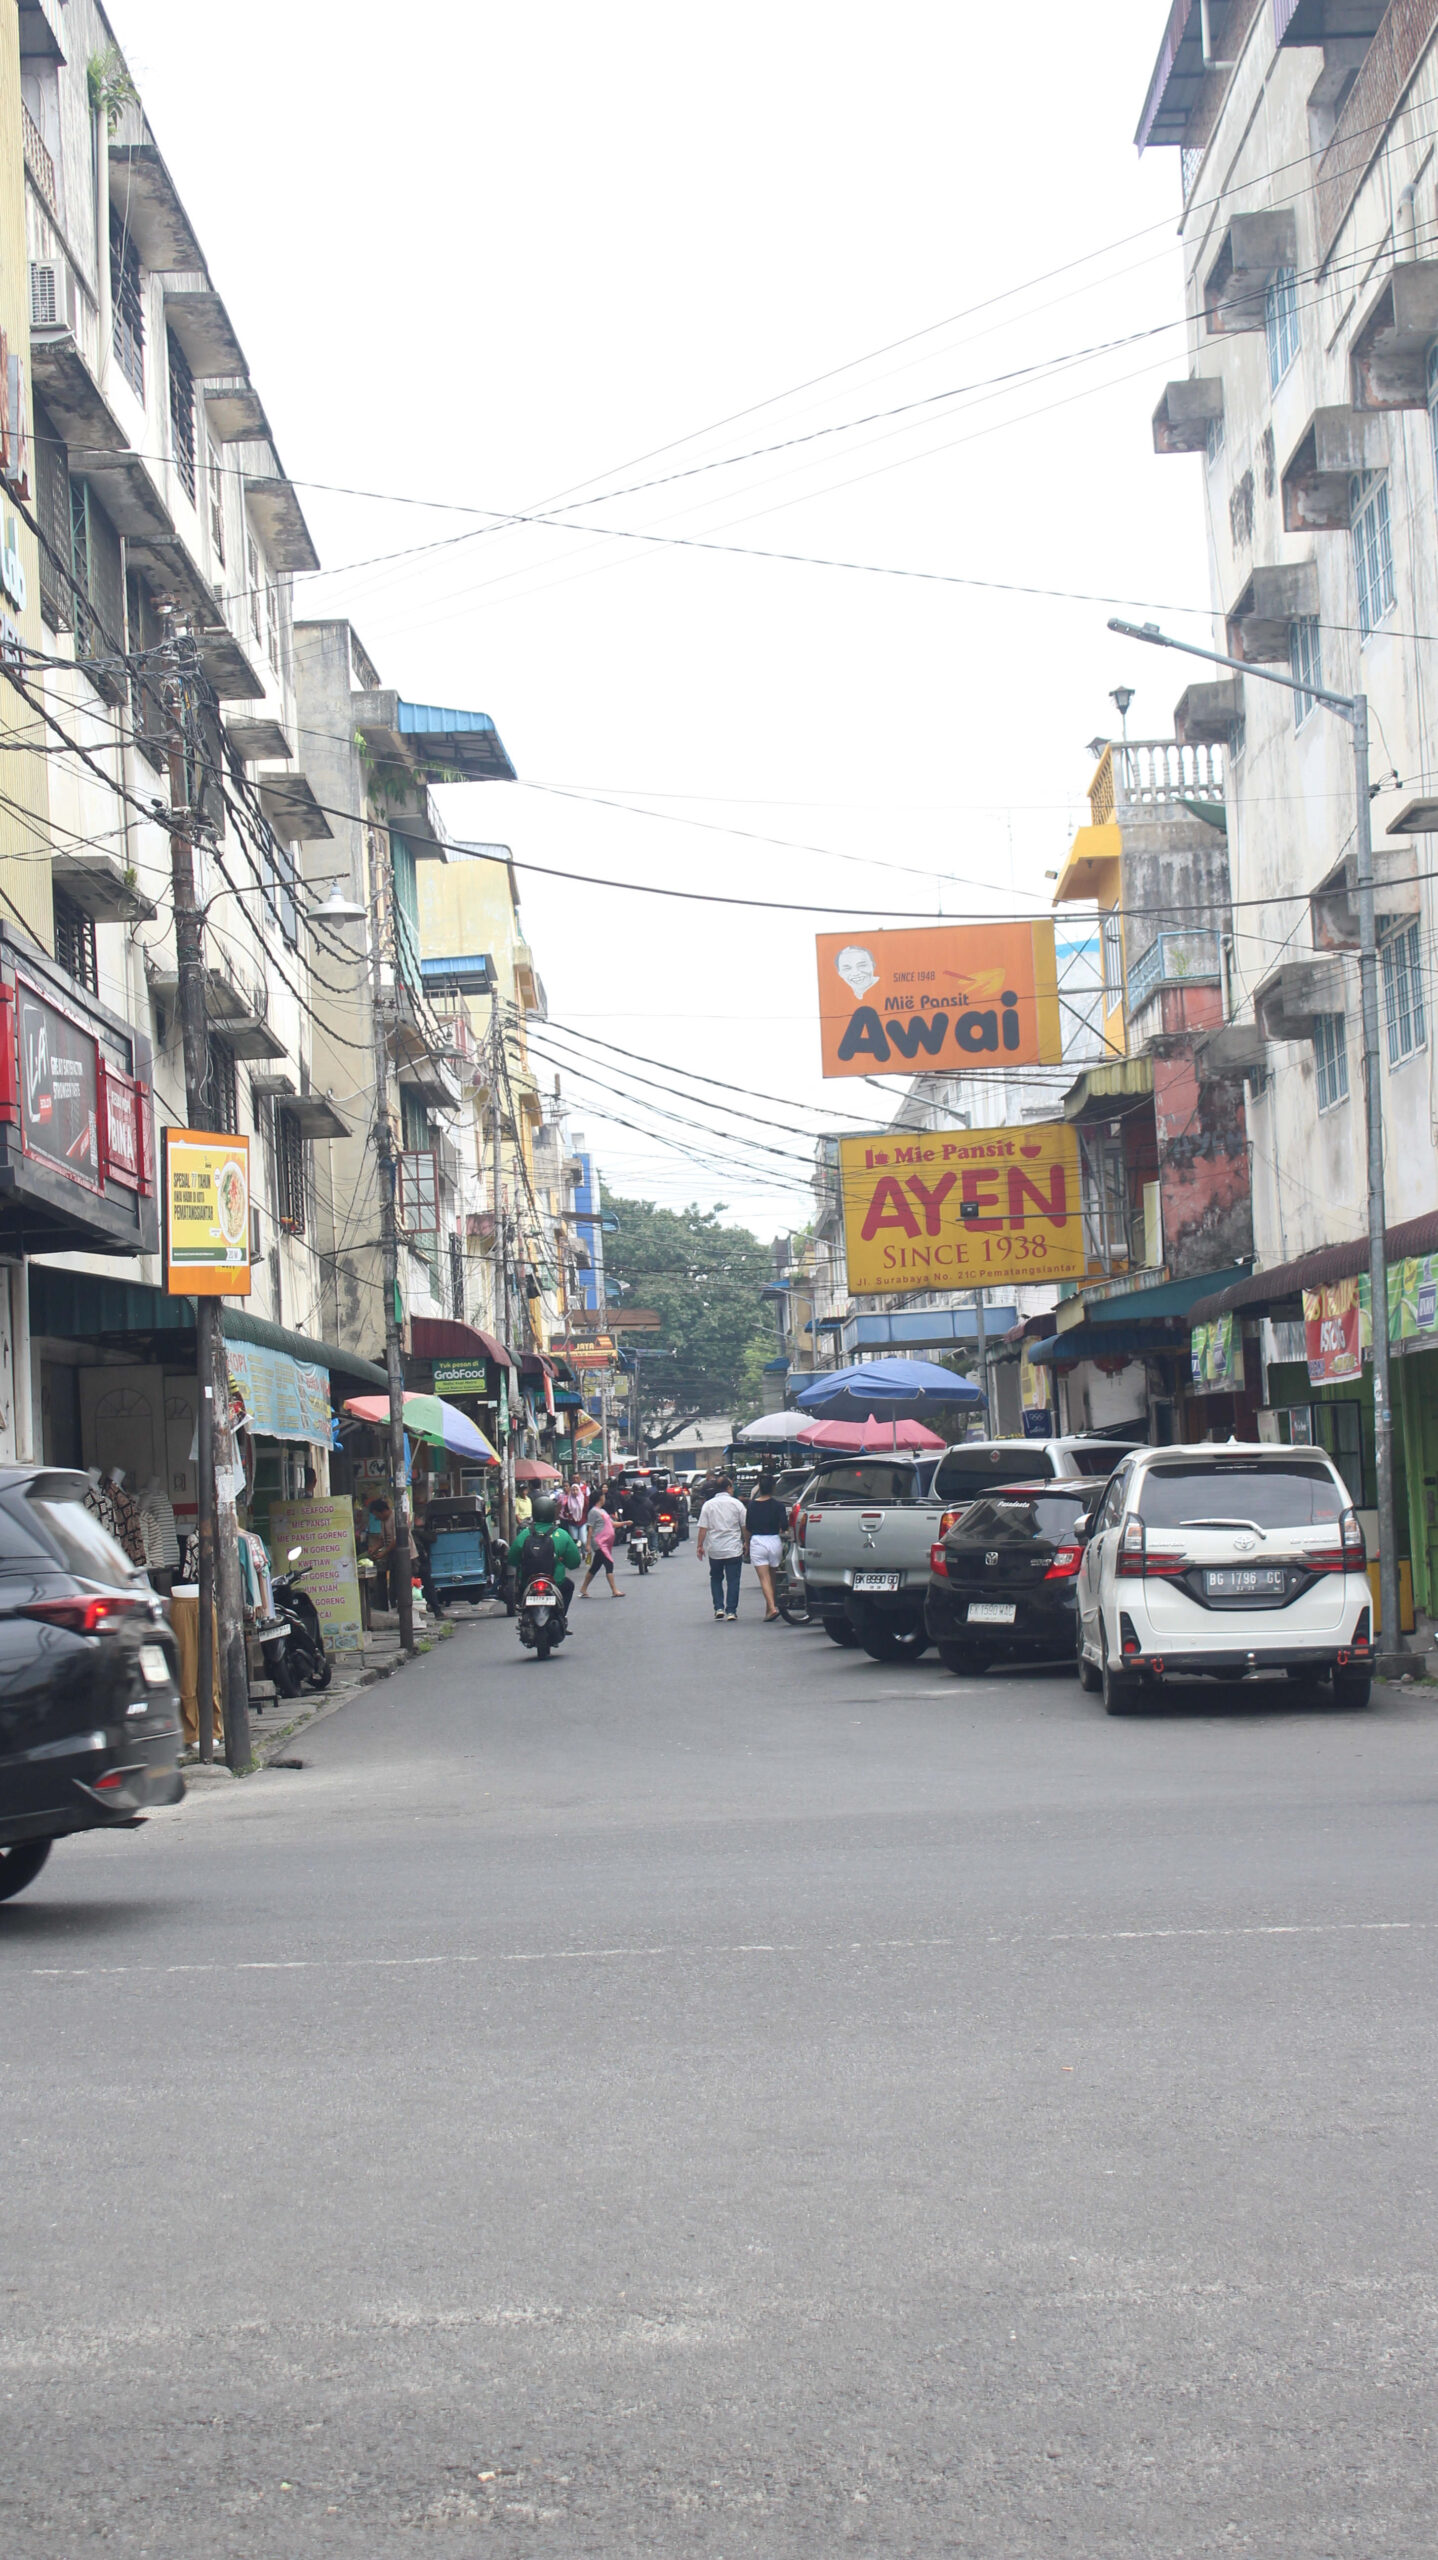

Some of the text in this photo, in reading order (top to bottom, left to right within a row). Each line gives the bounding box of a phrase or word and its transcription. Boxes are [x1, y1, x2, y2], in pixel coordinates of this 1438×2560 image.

[917, 971, 935, 982] 1948
[920, 993, 969, 1009] Pansit
[837, 990, 1020, 1062] Awai
[895, 1140, 1015, 1164] Mie Pansit
[861, 1164, 1067, 1241] AYEN
[983, 1234, 1047, 1262] 1938
[876, 1274, 930, 1286] Surabaya
[934, 1272, 952, 1281] No.
[957, 1270, 976, 1279] 21C
[979, 1263, 1077, 1278] Pematangsiantar
[434, 1367, 485, 1380] GrabFood
[301, 1505, 334, 1515] SEAFOOD
[292, 1518, 330, 1529] MIE PANSIT
[277, 1531, 348, 1543] MIE PANSIT GORENG
[311, 1544, 340, 1553] GORENG
[298, 1559, 330, 1567] KWETIAW
[310, 1571, 340, 1580] GORENG
[1209, 1571, 1281, 1586] BG 1796 GC
[318, 1584, 338, 1592] KUAH
[315, 1597, 346, 1606] GORENG
